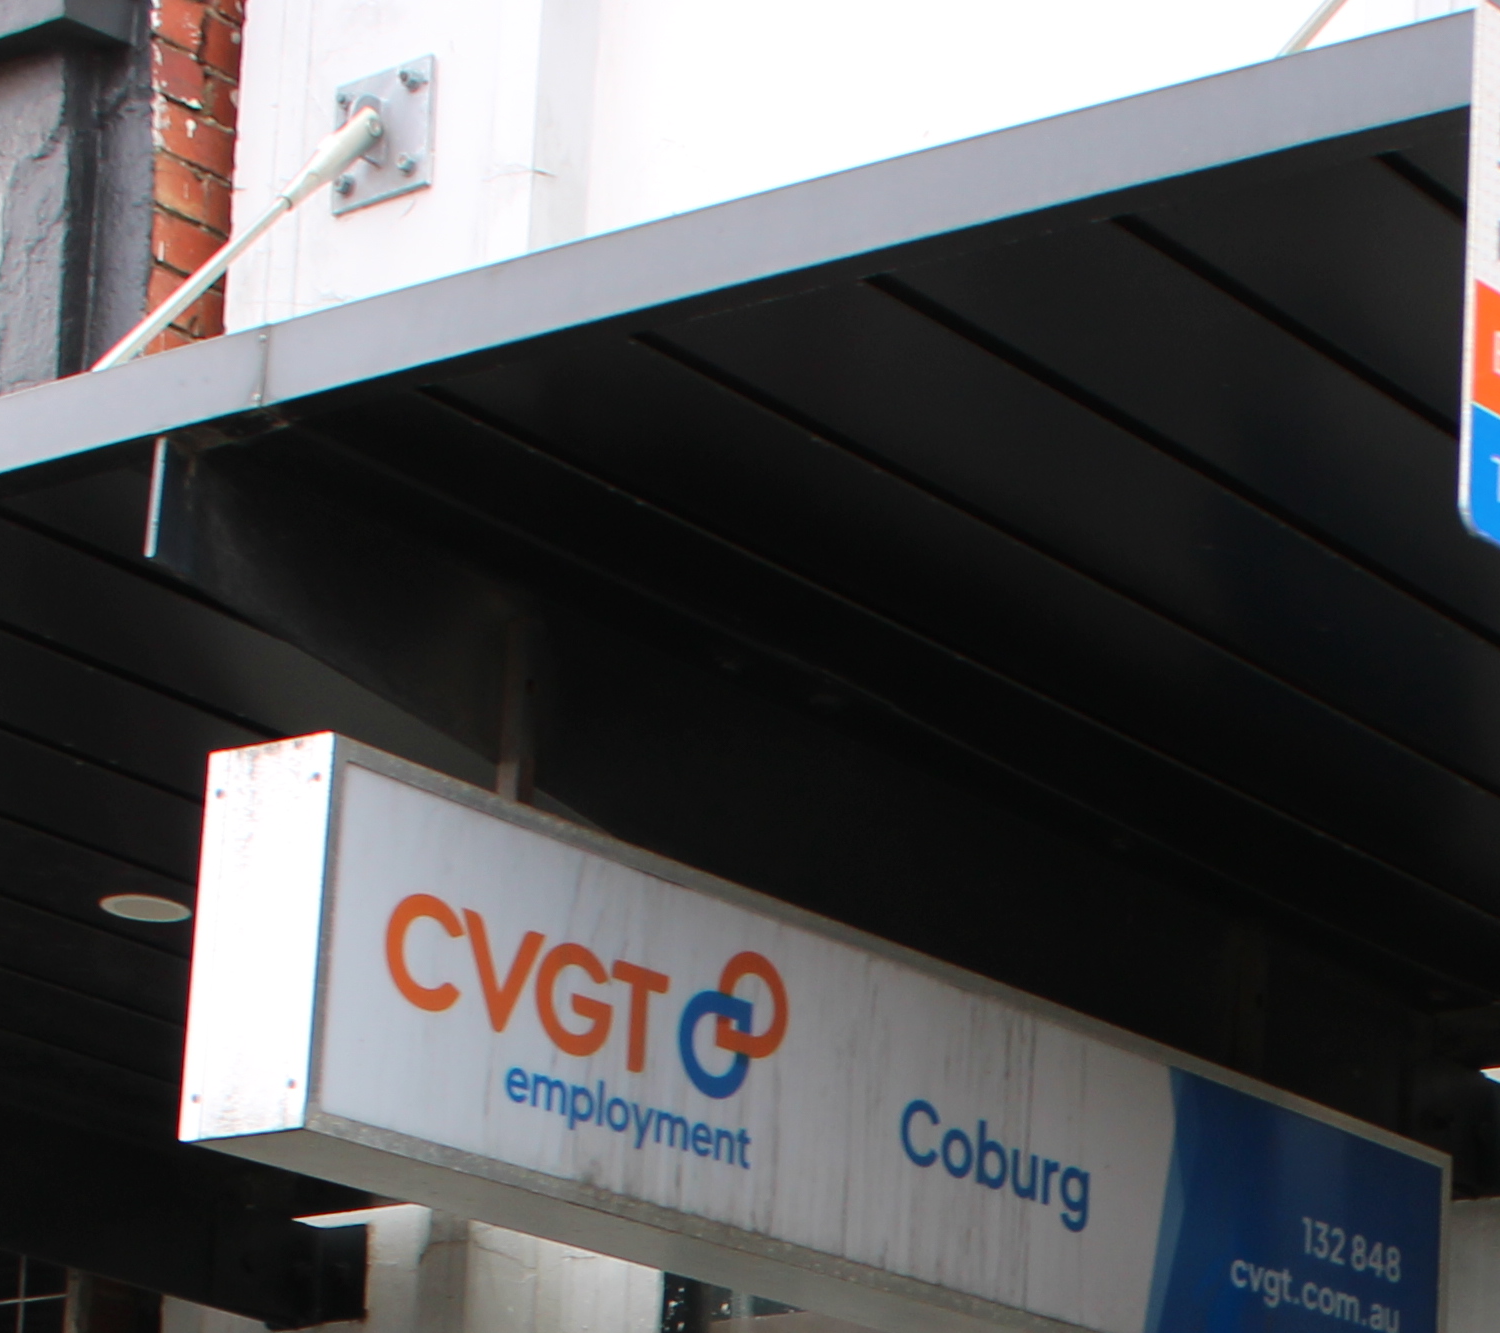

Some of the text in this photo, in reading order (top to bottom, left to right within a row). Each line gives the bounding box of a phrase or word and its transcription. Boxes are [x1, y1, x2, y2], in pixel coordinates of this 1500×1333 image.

[385, 893, 669, 1073] CVGT
[504, 1060, 752, 1170] employment
[899, 1098, 1092, 1234] Coburg
[1300, 1216, 1401, 1283] 132 848
